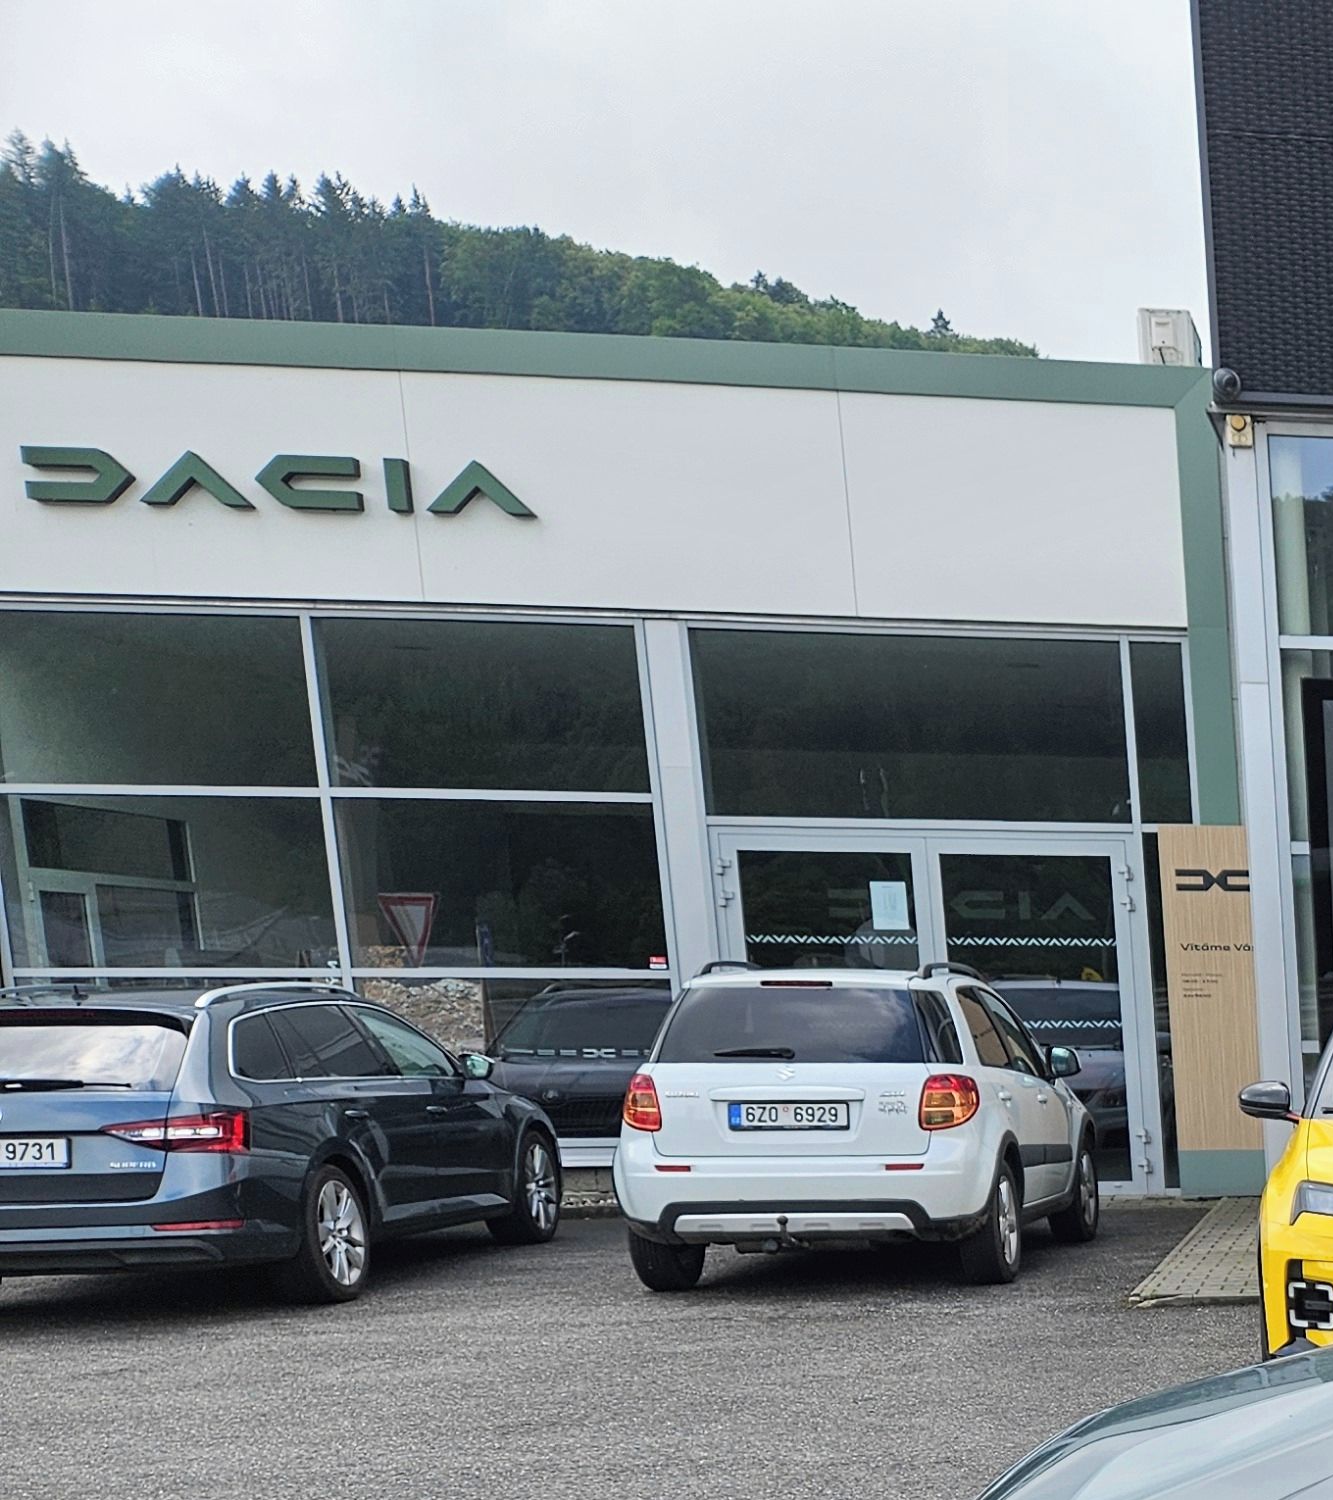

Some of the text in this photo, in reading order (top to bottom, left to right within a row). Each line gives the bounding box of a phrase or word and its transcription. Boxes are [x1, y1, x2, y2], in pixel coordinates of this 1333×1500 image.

[20, 445, 538, 519] DACIA
[745, 1106, 779, 1123] 6Z0
[793, 1106, 839, 1123] 6929
[5, 1142, 55, 1161] 9731
